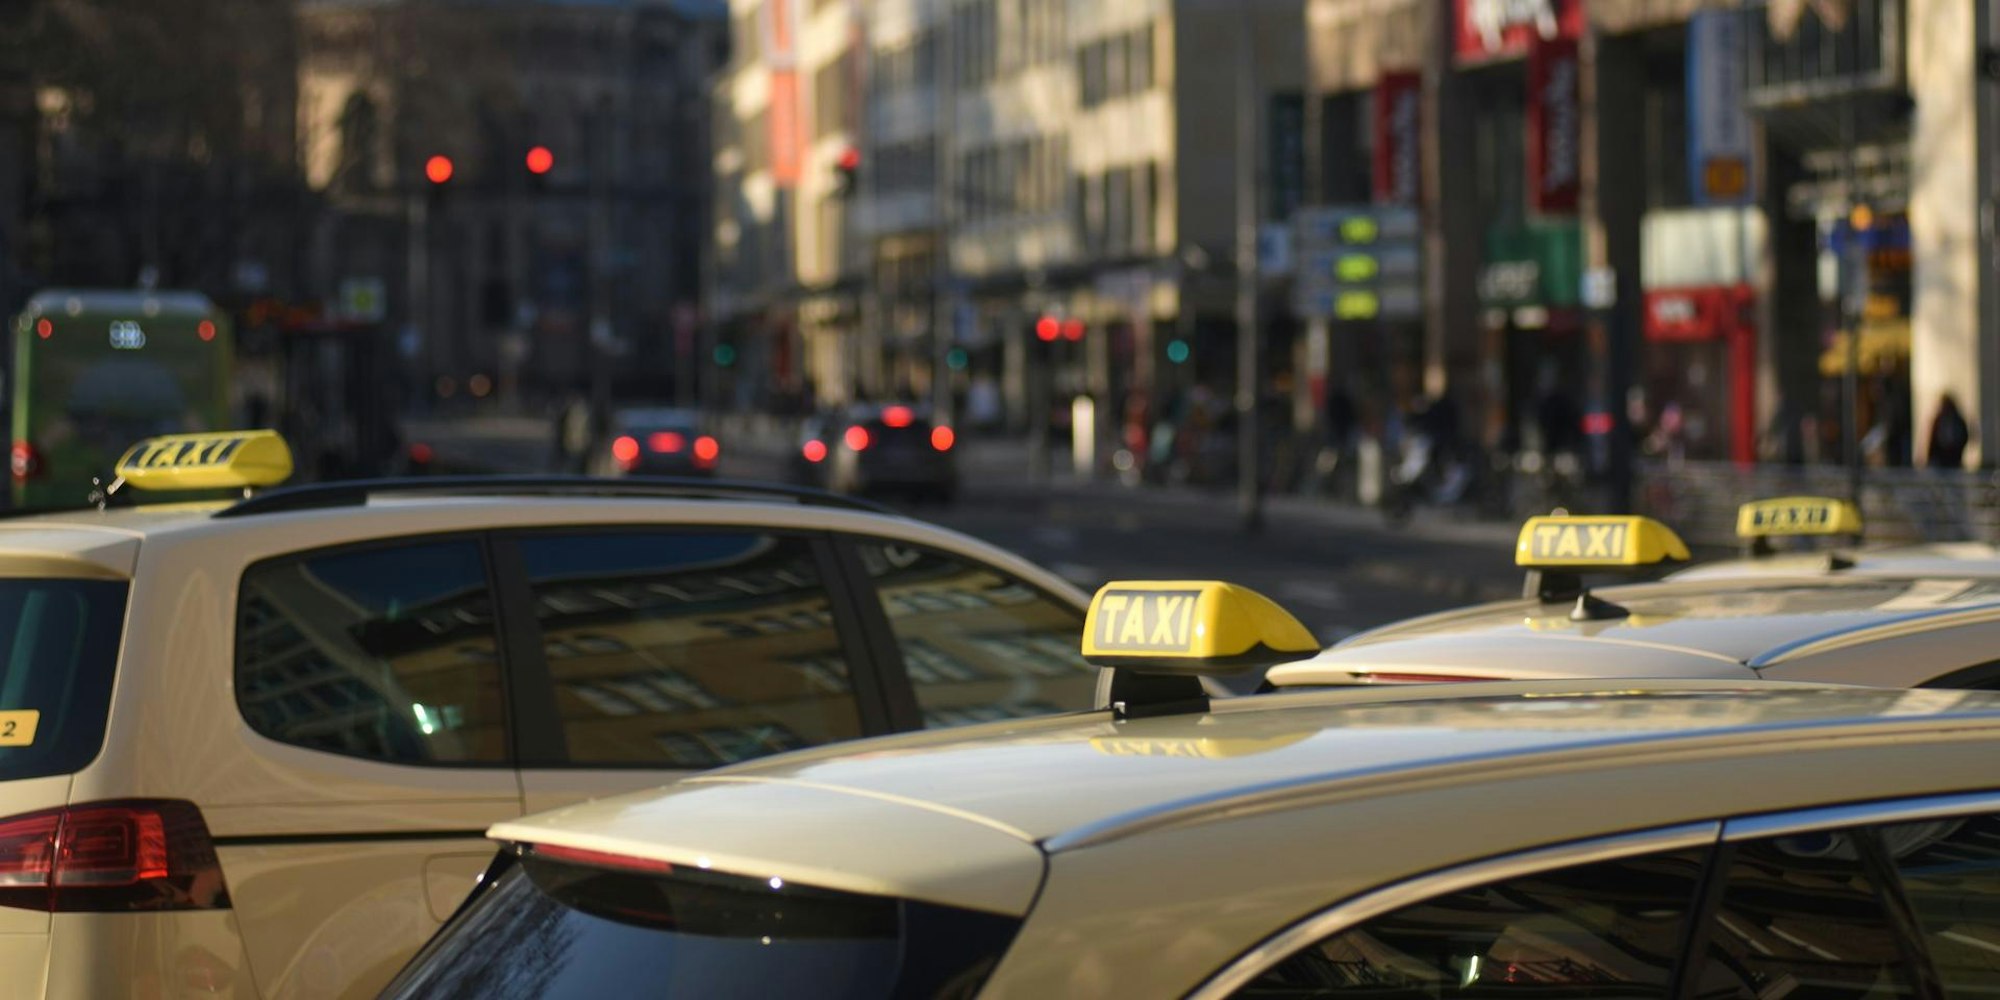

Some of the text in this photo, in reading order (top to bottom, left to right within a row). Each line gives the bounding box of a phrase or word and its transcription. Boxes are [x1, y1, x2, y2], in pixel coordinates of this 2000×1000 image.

[137, 439, 234, 468] TAXI
[1757, 507, 1823, 529] TAXI
[1535, 525, 1625, 557] TAXI
[1102, 595, 1195, 645] TAXI
